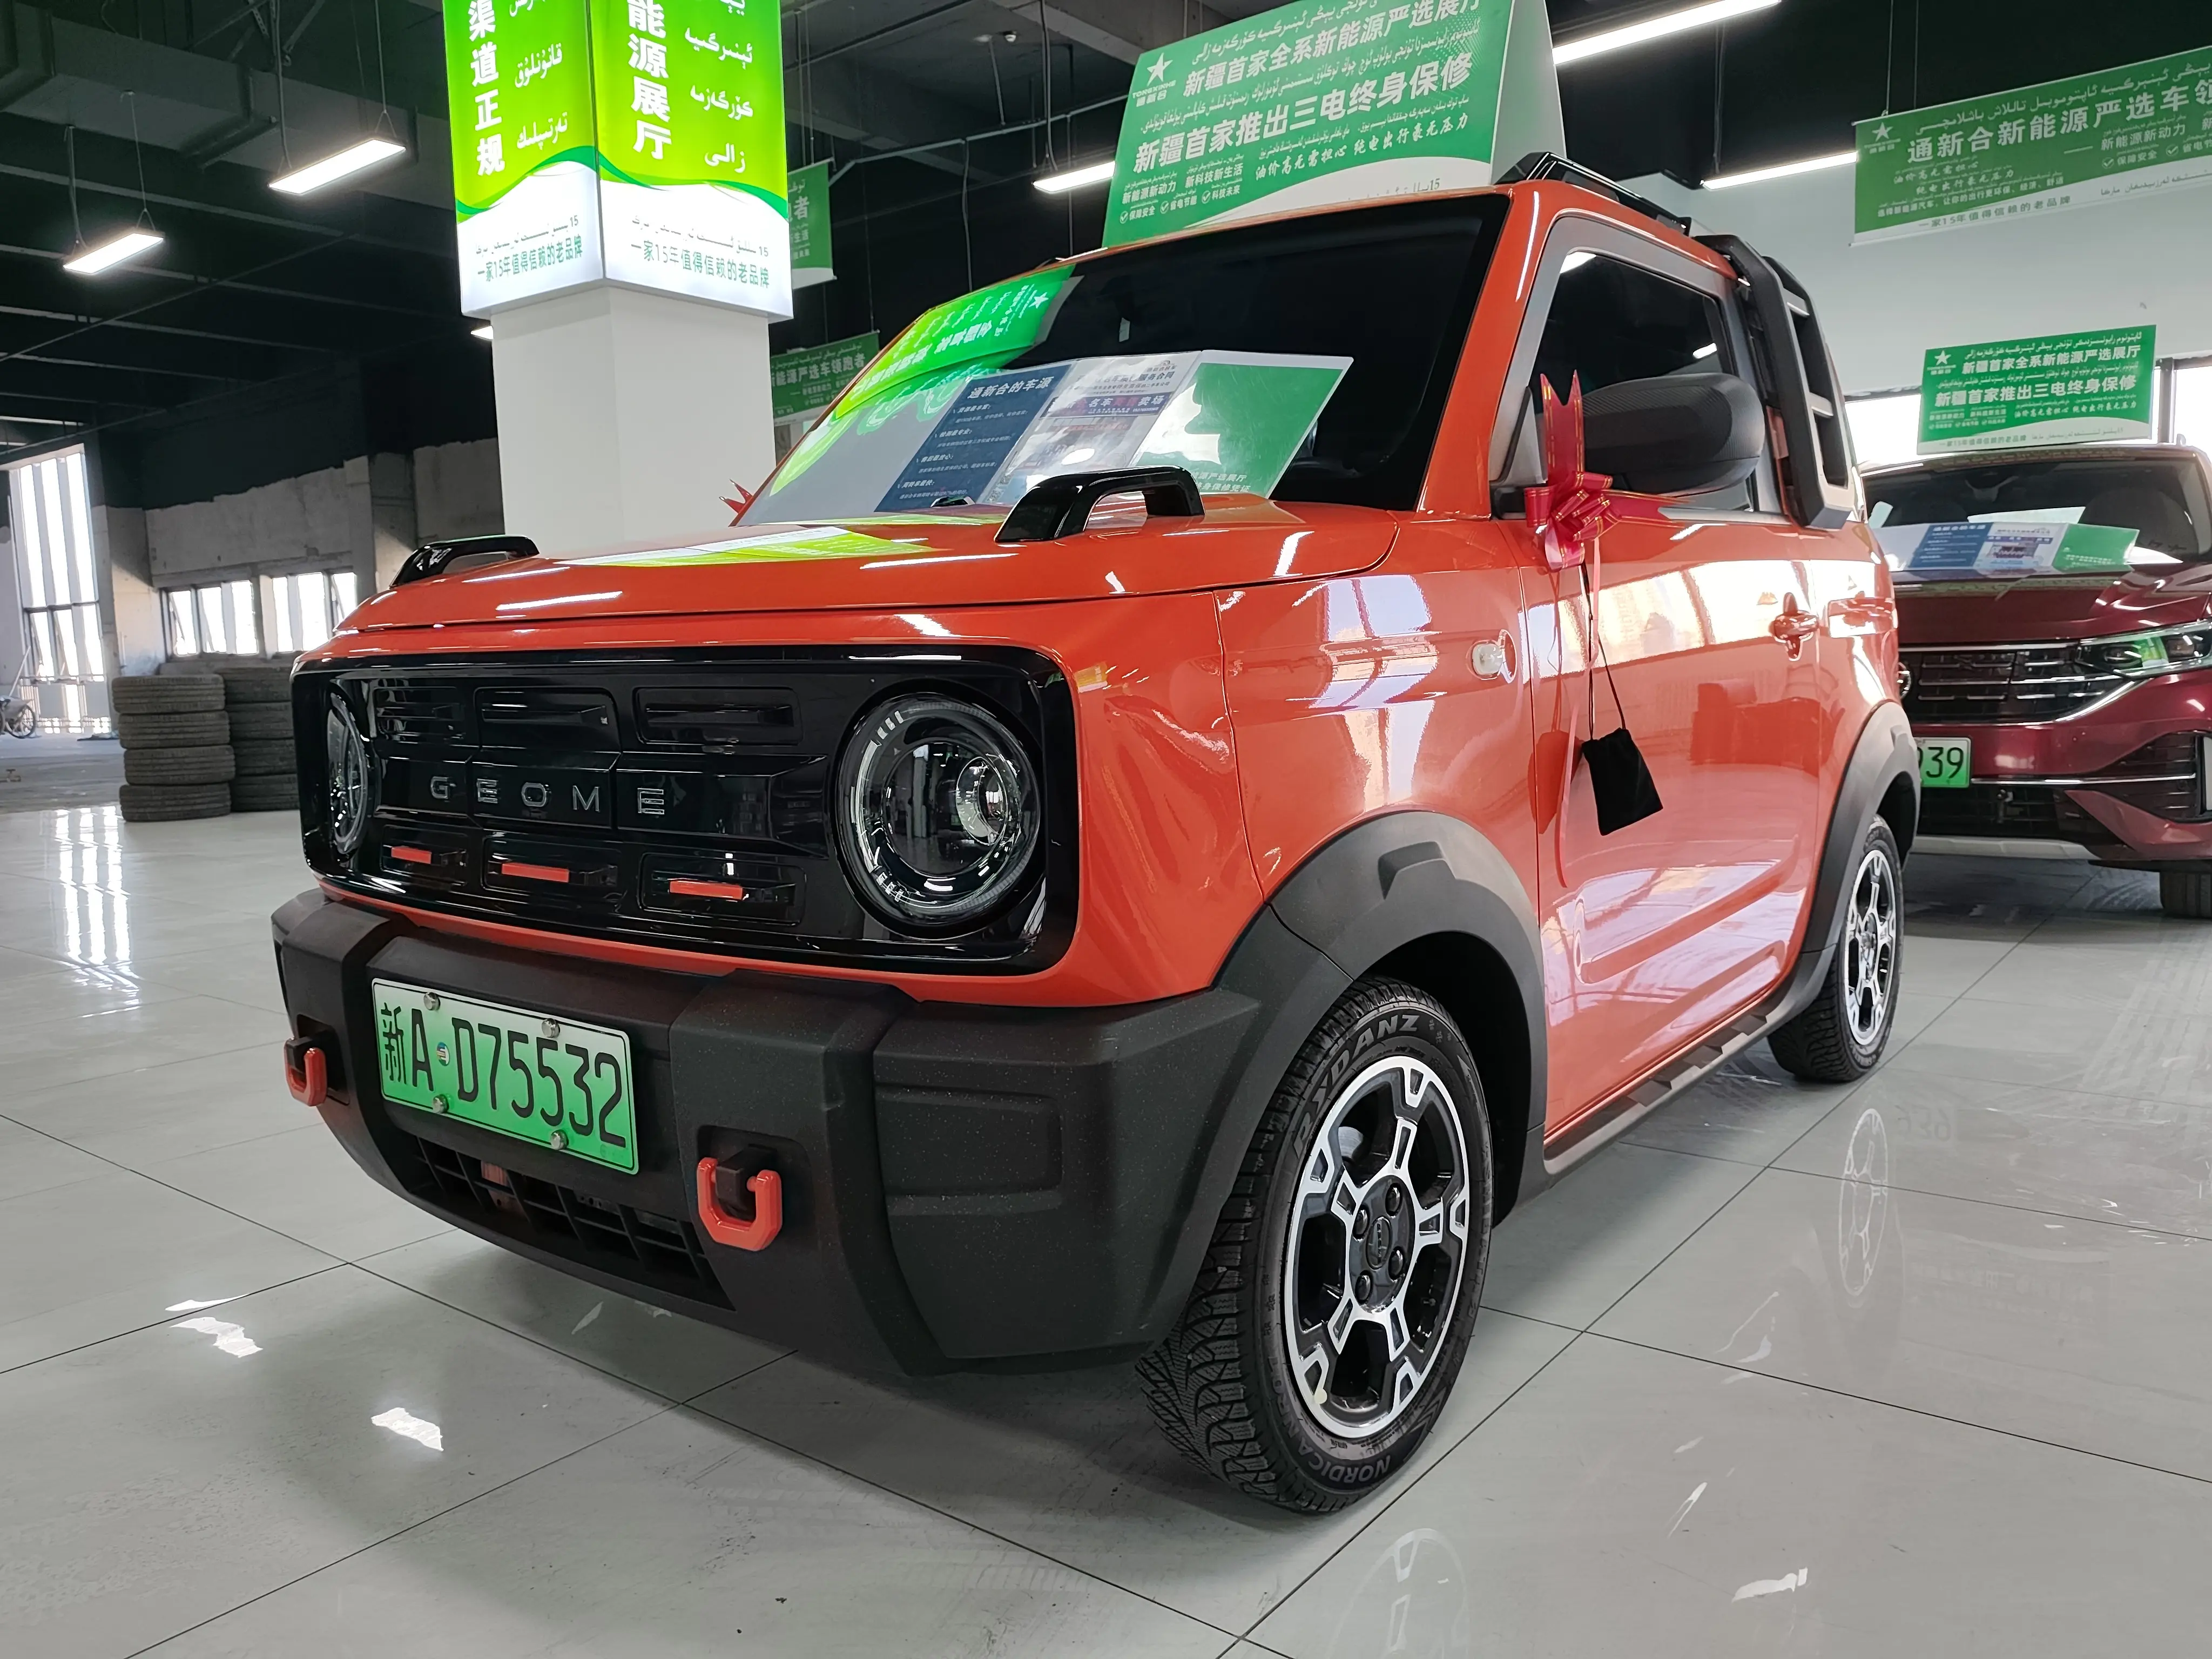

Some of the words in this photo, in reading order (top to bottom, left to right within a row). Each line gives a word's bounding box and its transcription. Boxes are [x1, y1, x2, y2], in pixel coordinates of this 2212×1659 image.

[468, 0, 505, 176] 渠道正规
[626, 0, 672, 160] 能源展厅
[1133, 52, 1473, 174] 新疆首家推出三电终身保修
[2101, 123, 2186, 151] 新能源新动力
[1255, 144, 1348, 181] 油价高无需担心
[2117, 149, 2157, 166] 保障安全
[1185, 163, 1244, 188] 新科技新生活
[1122, 181, 1177, 204] 新能源新动力
[1918, 195, 2071, 228] 一家15年值得信赖的老品牌
[1961, 345, 2141, 374] 新疆首家全系新能源严选展厅
[967, 376, 1055, 399] 通新合的车源
[1934, 374, 2137, 407] 新疆首家推出三电终身保修
[430, 776, 665, 816] GEOME
[1298, 1436, 1392, 1483] NORDICA
